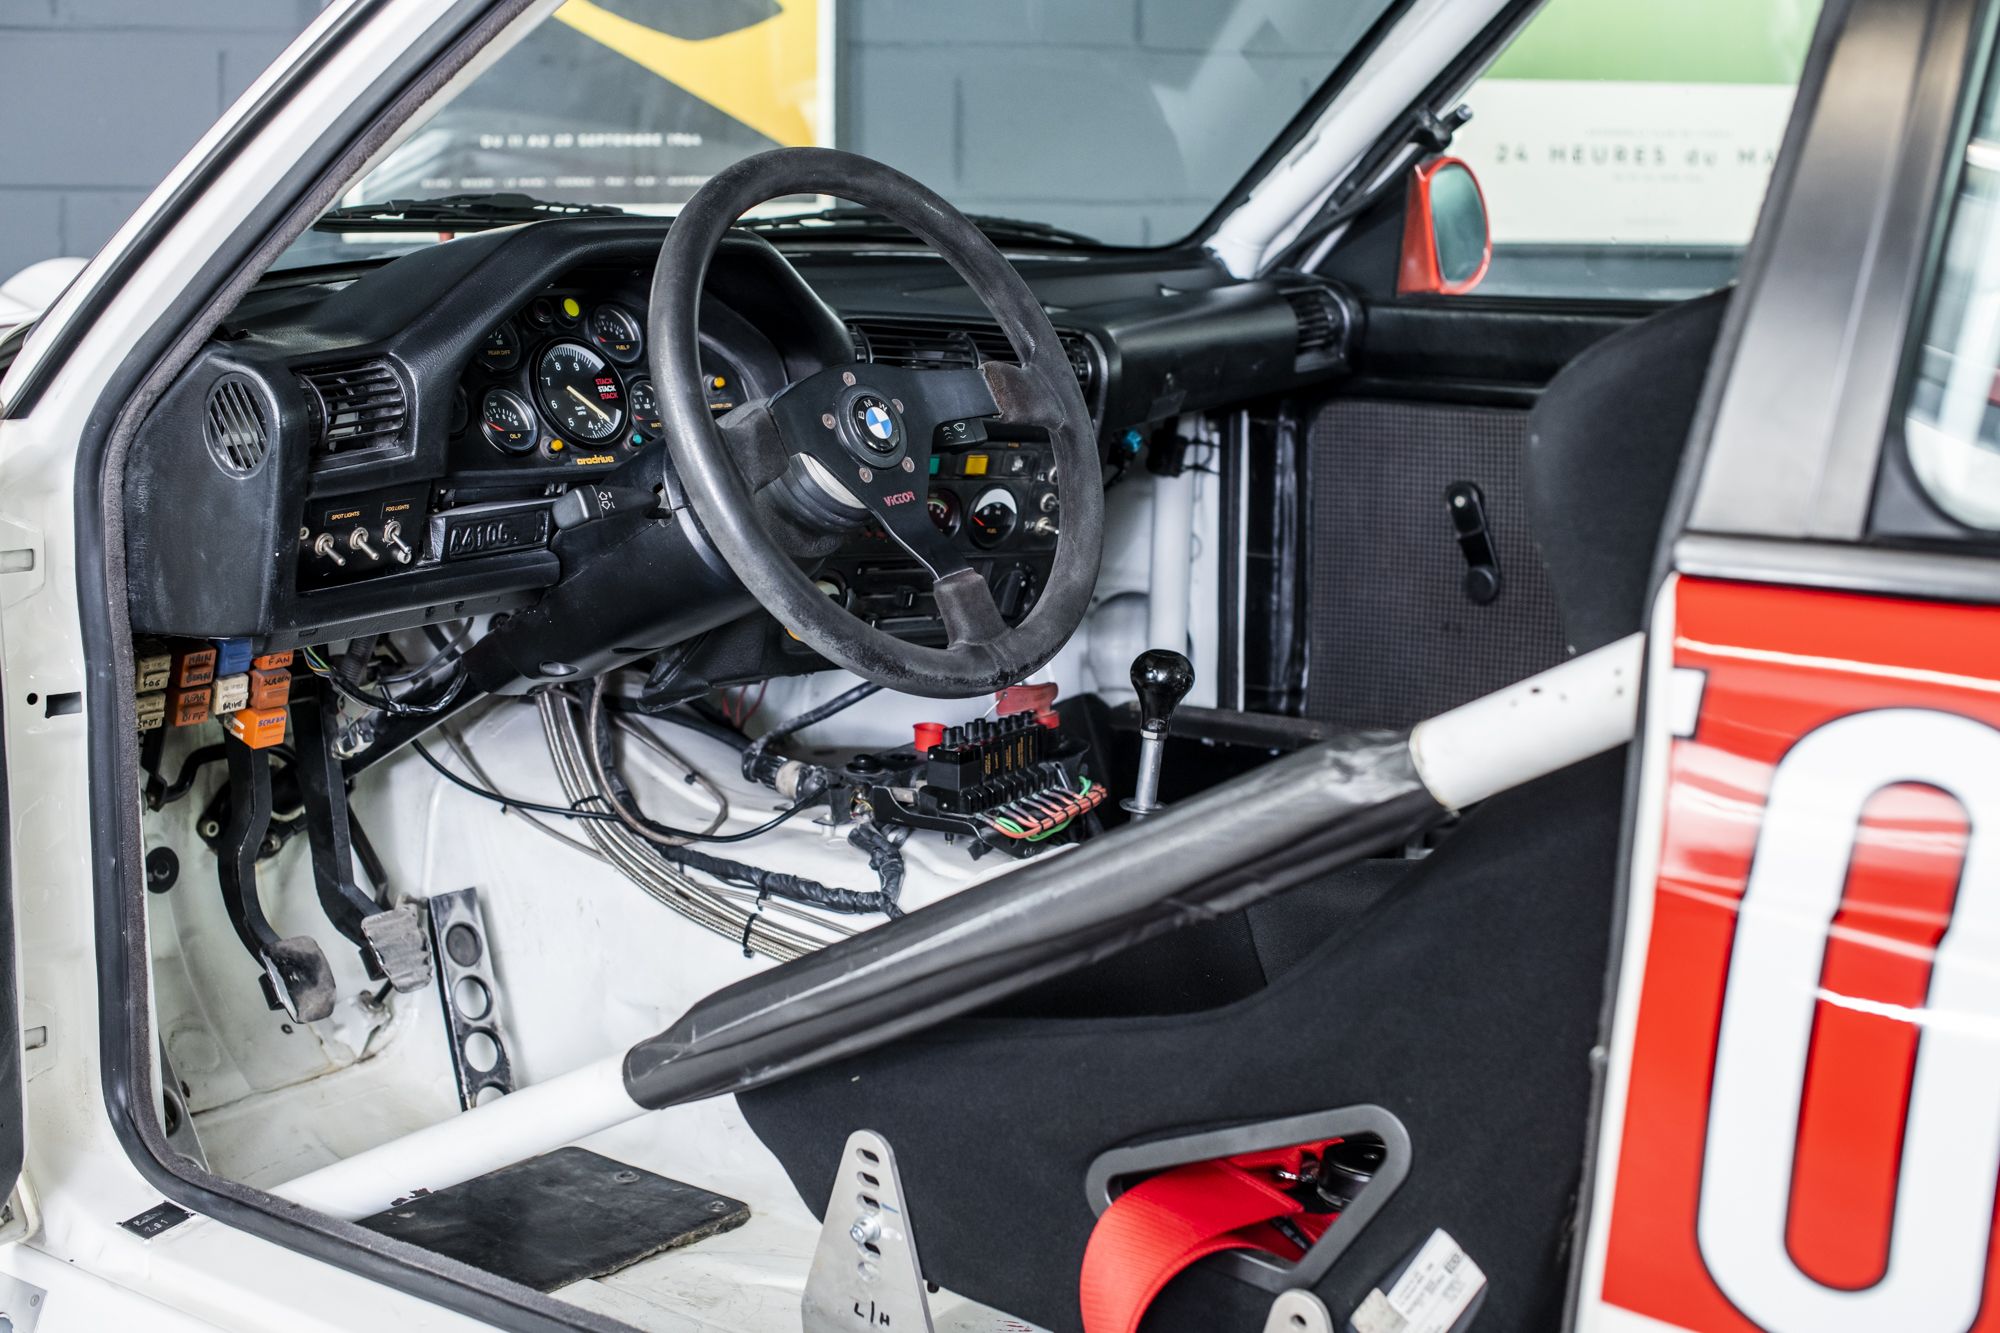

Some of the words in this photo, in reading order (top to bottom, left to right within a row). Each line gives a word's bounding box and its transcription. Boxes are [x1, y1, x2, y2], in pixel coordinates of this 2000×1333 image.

[480, 134, 503, 149] DU
[577, 133, 662, 148] SEPTEMBRE
[1495, 143, 1529, 164] 24
[1548, 144, 1667, 165] HEURES
[1736, 147, 1776, 165] MA
[554, 362, 561, 371] 8
[573, 362, 580, 372] 9
[545, 377, 551, 386] 7
[598, 385, 616, 393] STACK
[600, 392, 618, 400] STACK
[551, 400, 558, 409] 6
[858, 399, 888, 420] BMW
[568, 418, 575, 427] 5
[587, 420, 594, 430] 4
[394, 503, 410, 511] LIGHTS
[331, 512, 345, 521] SPOT
[344, 510, 361, 518] LIGHTS
[189, 654, 211, 666] MAIN
[269, 656, 290, 666] FAN
[144, 680, 160, 689] FOG
[138, 718, 159, 730] SPOT
